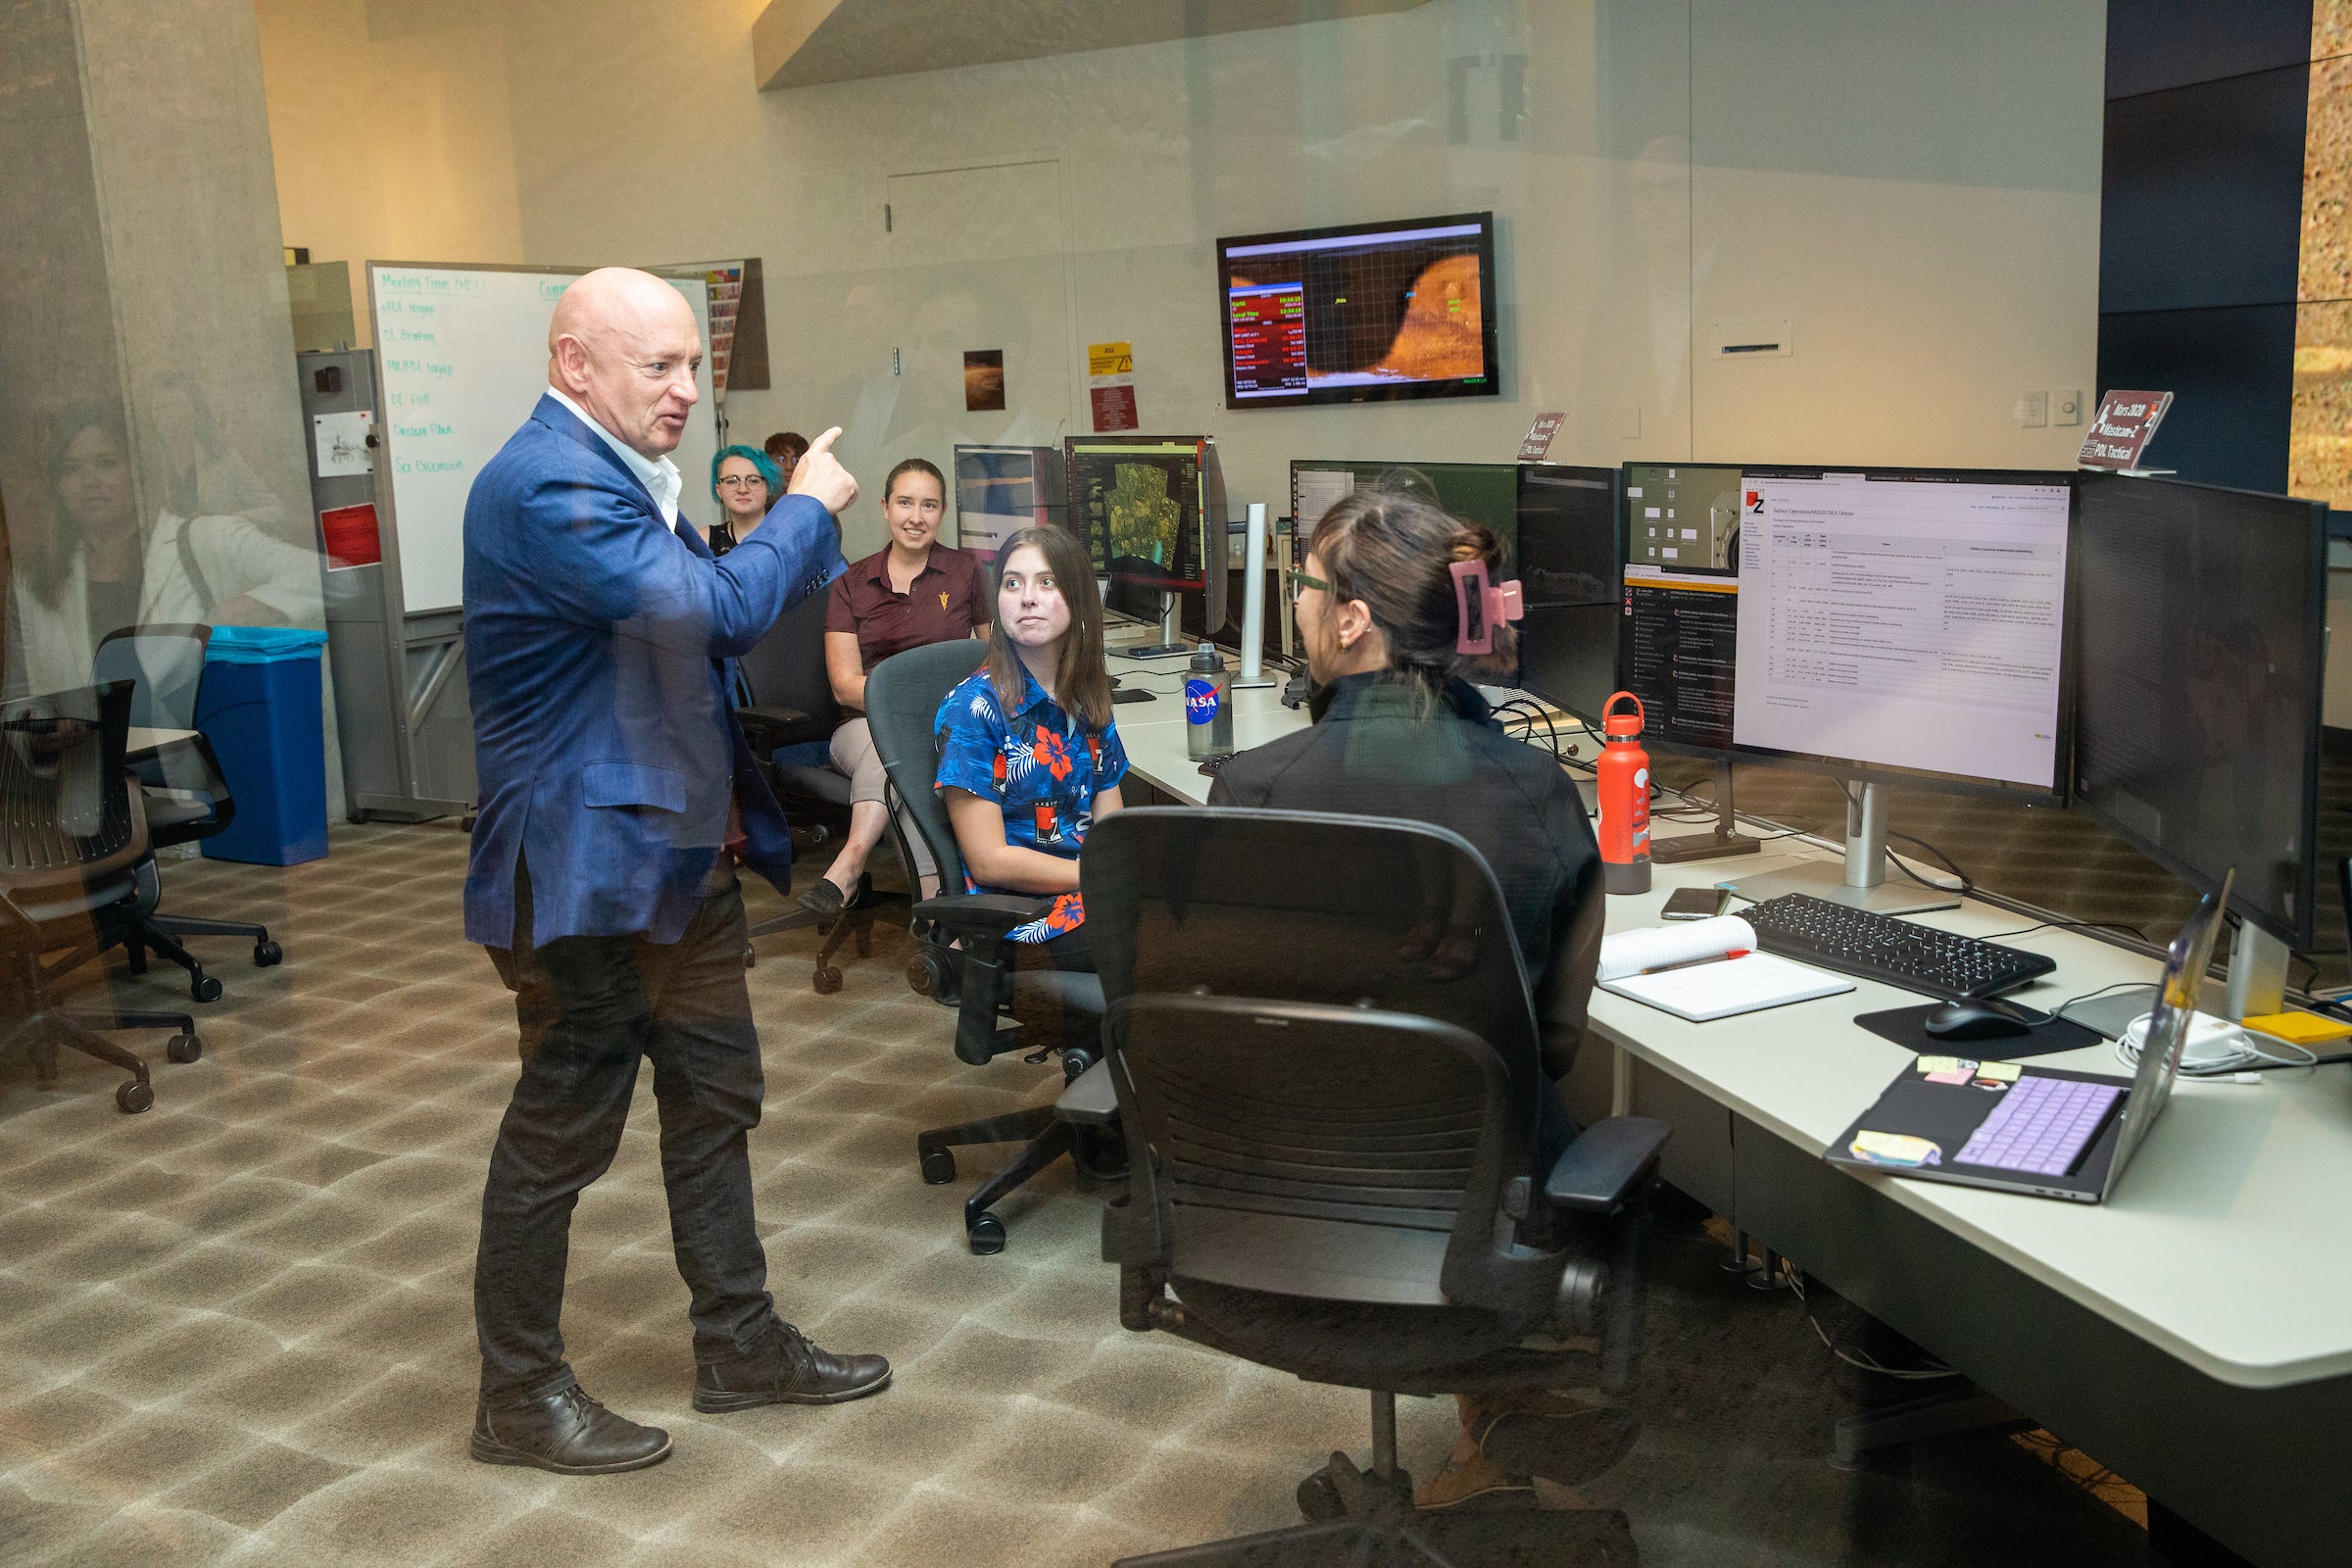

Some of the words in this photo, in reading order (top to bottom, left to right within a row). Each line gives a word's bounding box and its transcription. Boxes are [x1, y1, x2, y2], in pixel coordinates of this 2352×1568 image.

[2112, 403, 2130, 416] Mars
[2128, 404, 2146, 417] 2020
[2102, 422, 2140, 438] Mastcam-Z
[2108, 444, 2133, 461] Tactical
[1186, 696, 1217, 708] NASA
